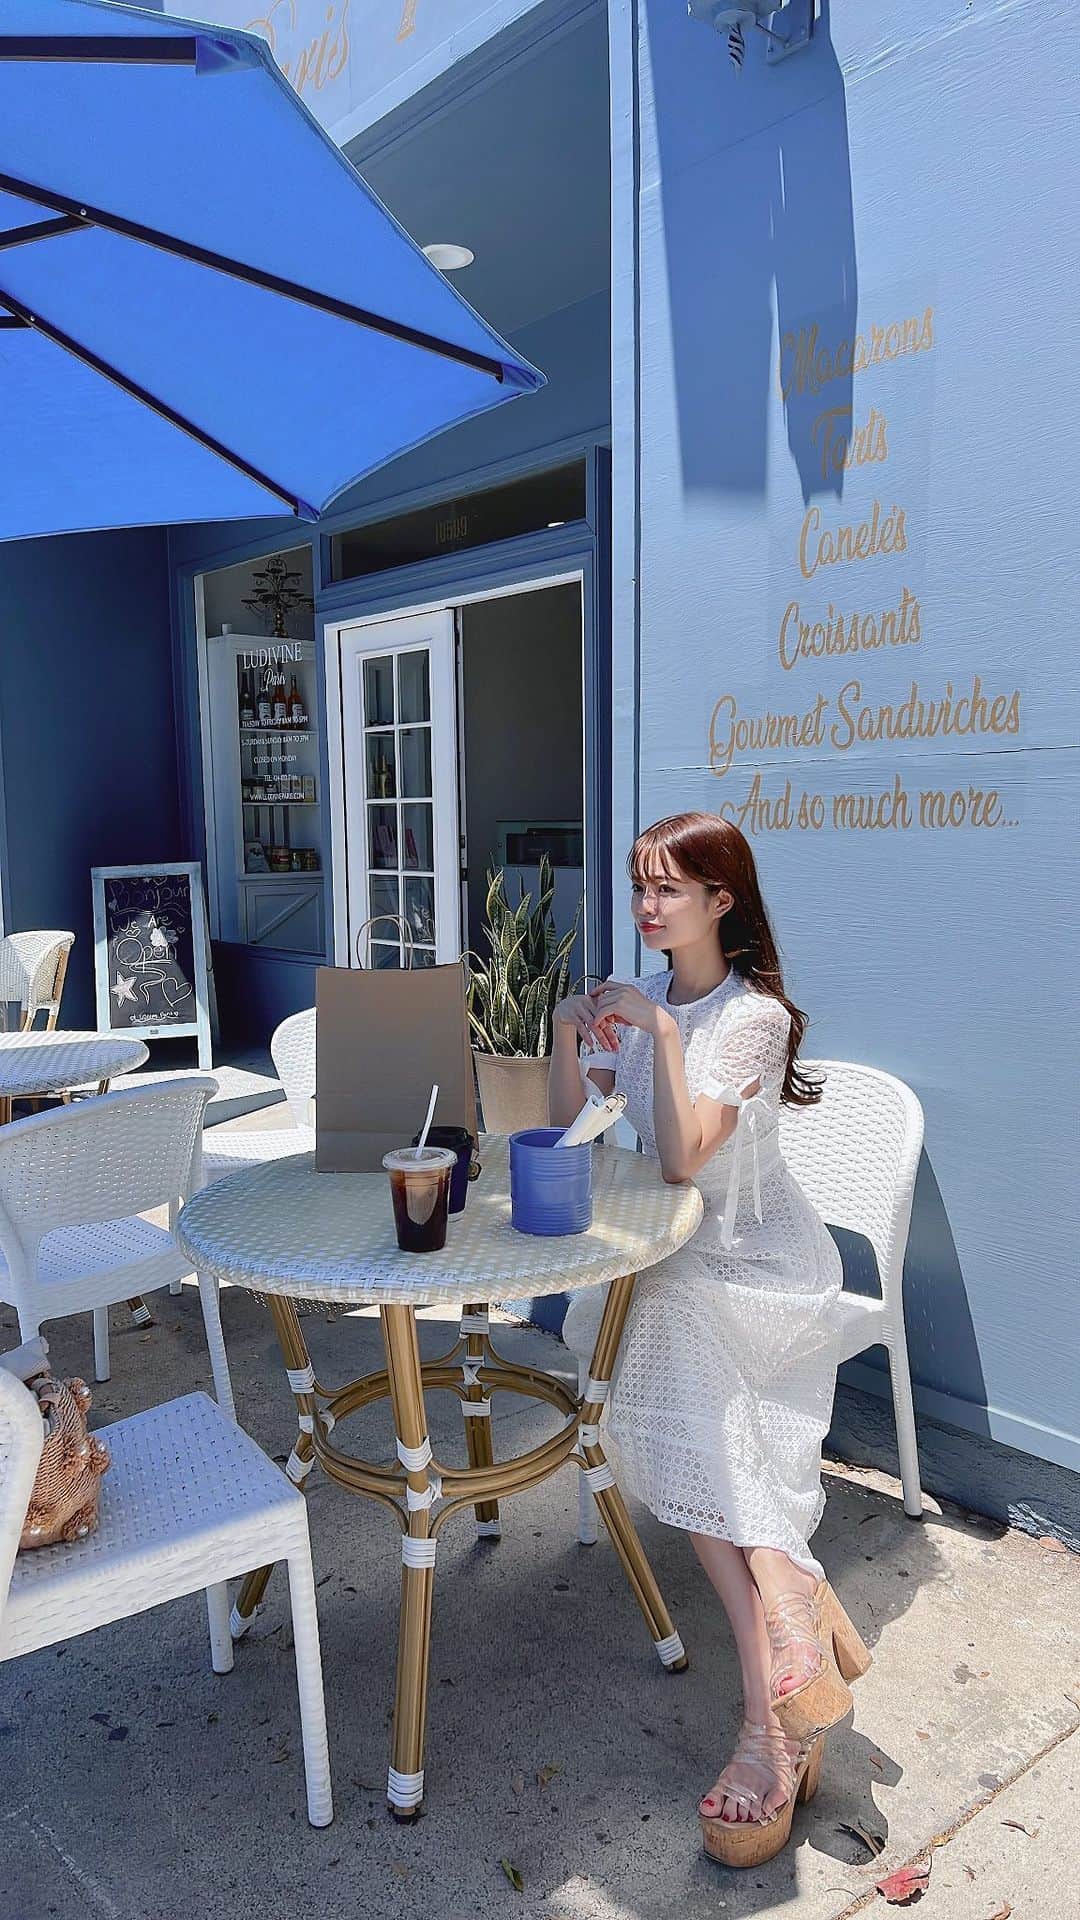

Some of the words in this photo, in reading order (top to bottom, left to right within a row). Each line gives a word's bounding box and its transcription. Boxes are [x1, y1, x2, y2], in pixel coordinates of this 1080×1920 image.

[776, 305, 934, 402] Macarons
[812, 406, 889, 481] Tarts
[242, 641, 303, 670] LUDIVINE
[778, 586, 922, 671] Croissants
[260, 667, 287, 693] Paris
[708, 693, 829, 777] Gourmet
[830, 674, 1021, 751] Sandwiches
[719, 772, 793, 836] And
[797, 791, 826, 832] so
[831, 772, 913, 833] much
[918, 783, 1020, 830] more...
[116, 937, 177, 973] Open
